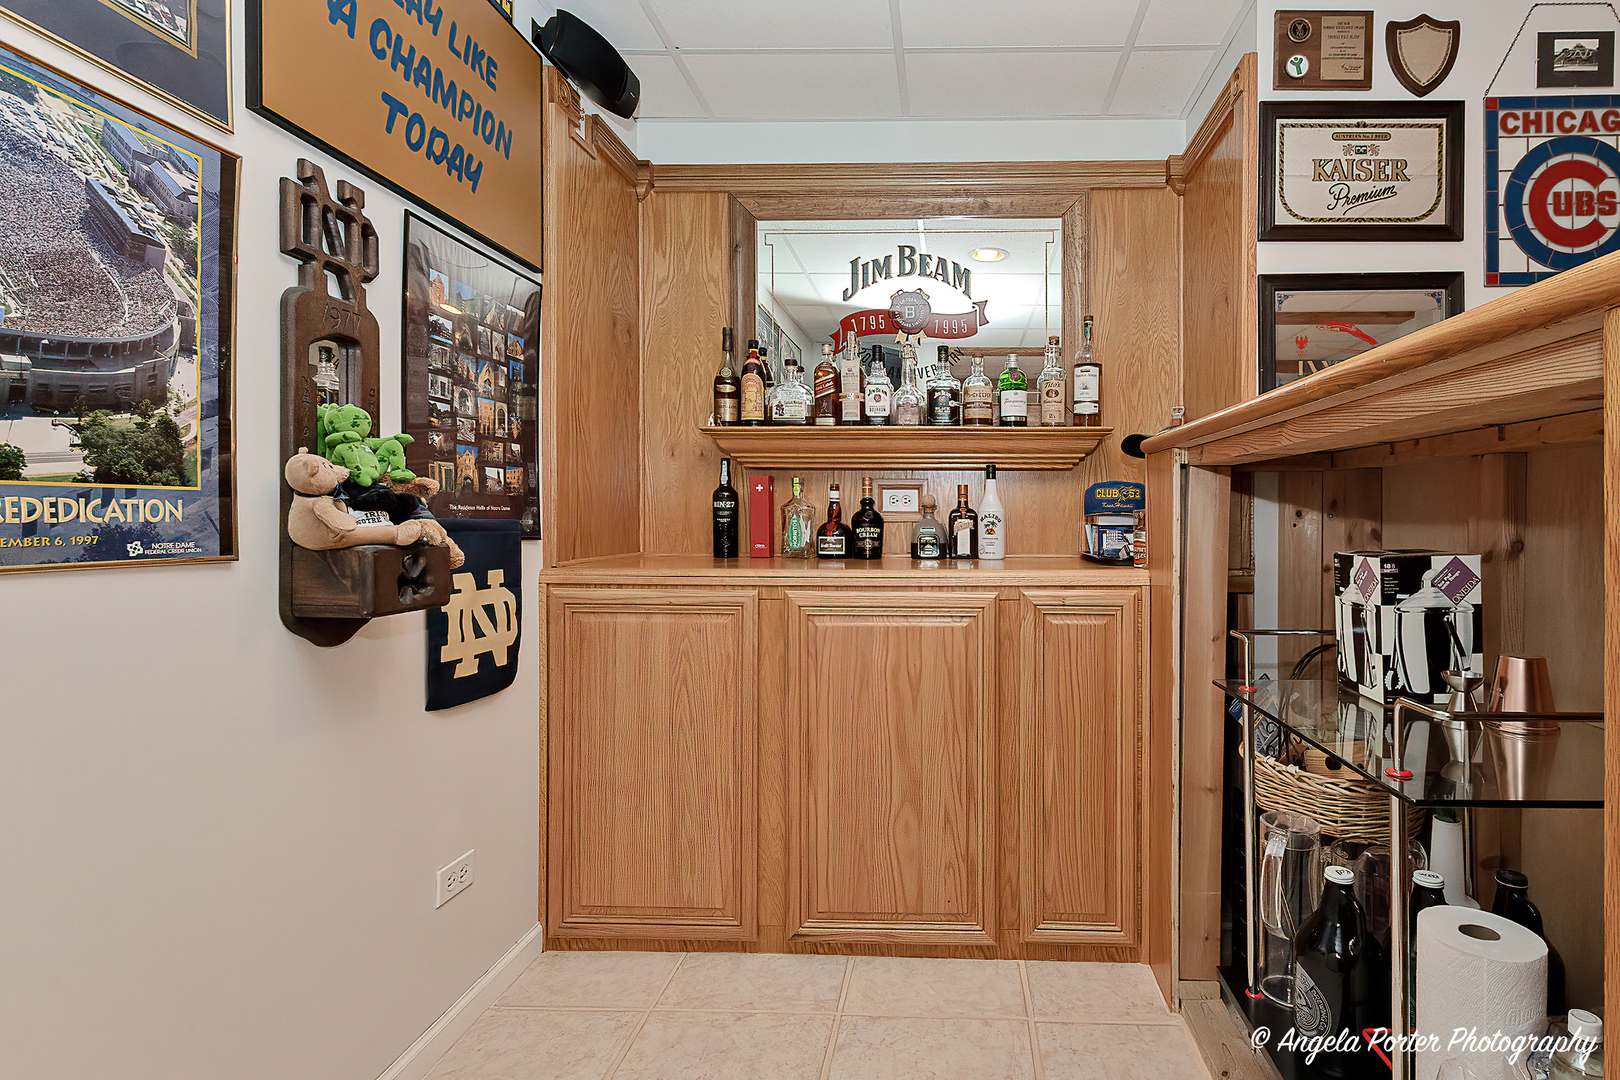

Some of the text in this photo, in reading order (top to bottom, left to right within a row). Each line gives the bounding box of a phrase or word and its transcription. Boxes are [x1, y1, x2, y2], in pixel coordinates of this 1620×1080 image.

[448, 20, 498, 92] LIKE
[327, 0, 513, 160] A CHAMPION
[381, 91, 483, 194] TODAY
[1312, 159, 1411, 181] KAISER
[1327, 183, 1397, 213] Premium
[1528, 160, 1618, 248] CUBS
[843, 245, 972, 301] JIM BEAM
[322, 303, 361, 336] 1977
[851, 315, 968, 335] 1795 1995
[905, 306, 915, 318] B
[1096, 488, 1141, 498] CLUB 53
[980, 514, 1002, 523] MALIBU
[54, 537, 67, 547] 6,
[70, 535, 99, 546] 1997
[175, 541, 196, 549] DAME
[1363, 578, 1378, 602] ONEIDA
[1452, 576, 1480, 604] ONEIDA
[441, 568, 518, 679] ND
